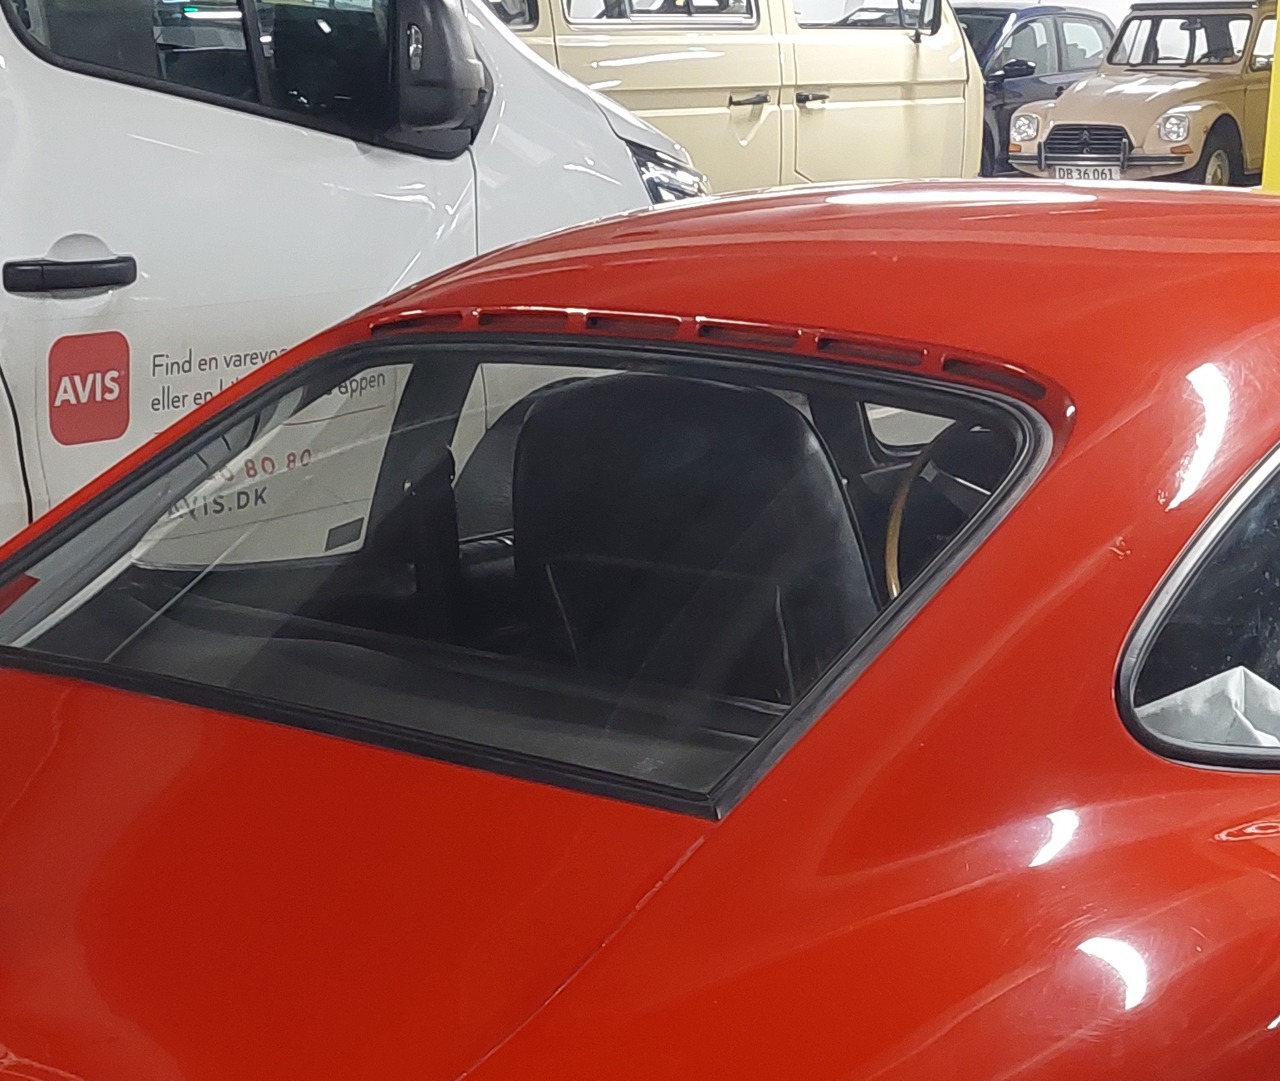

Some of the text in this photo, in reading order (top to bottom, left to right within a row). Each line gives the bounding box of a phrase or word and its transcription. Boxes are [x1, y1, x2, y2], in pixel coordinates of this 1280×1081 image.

[1075, 168, 1090, 180] 36
[1092, 168, 1113, 181] 061
[152, 348, 192, 377] Find
[198, 356, 218, 371] en
[54, 370, 121, 407] AVIS
[151, 384, 189, 411] eller
[193, 391, 214, 406] en
[244, 456, 276, 478] 80
[286, 448, 312, 470] 80
[168, 486, 268, 522] AVIS.DK
